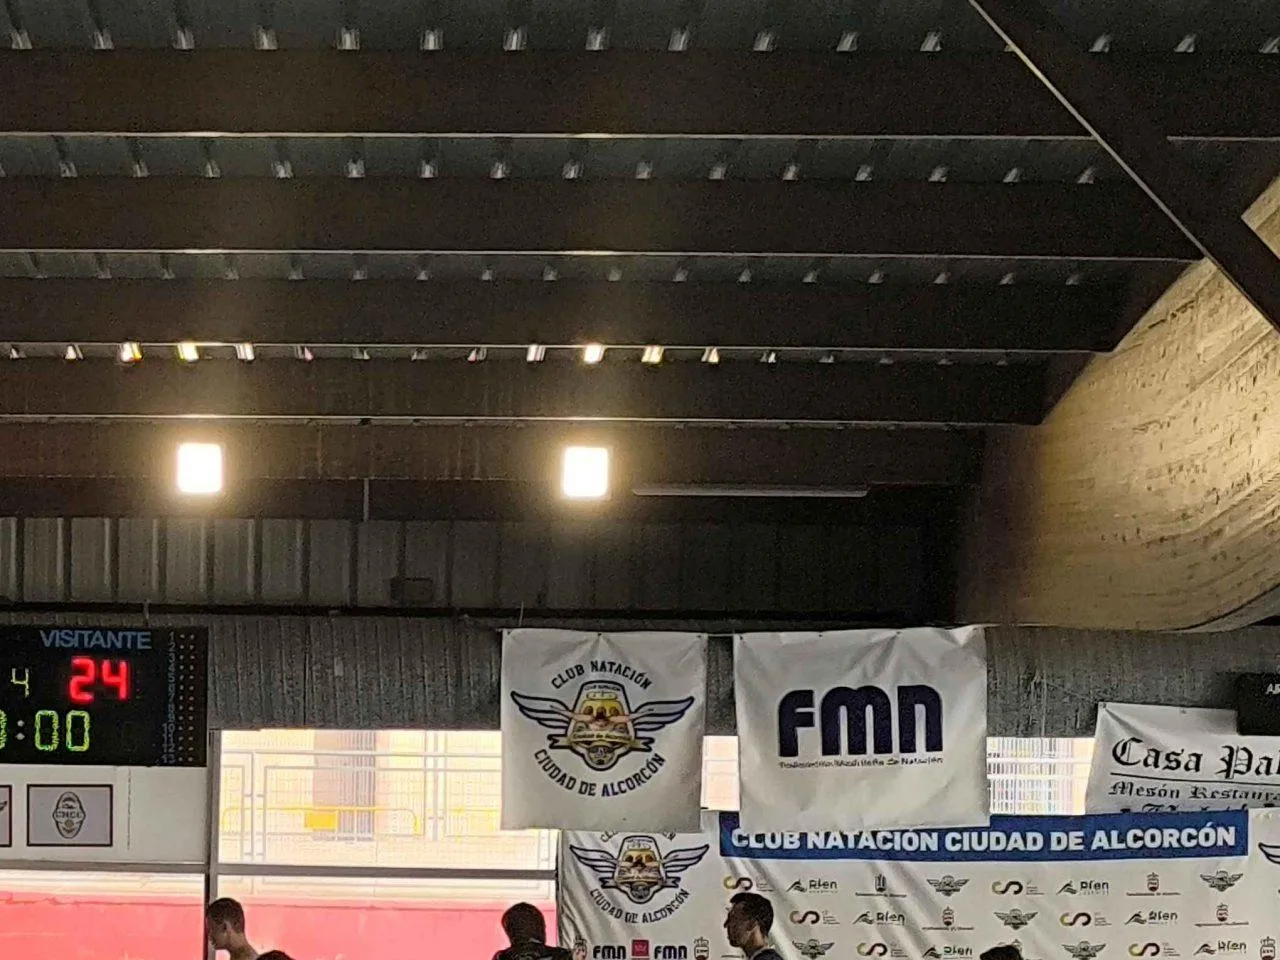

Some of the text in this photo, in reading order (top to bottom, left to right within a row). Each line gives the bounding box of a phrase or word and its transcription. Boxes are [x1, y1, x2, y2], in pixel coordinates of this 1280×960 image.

[40, 630, 152, 649] VISITANTE
[11, 668, 29, 697] 4
[69, 656, 128, 702] 24
[551, 660, 652, 690] CLUB NATACIÓN
[1112, 737, 1203, 773] Casa
[534, 749, 666, 797] CIUDAD DE ALCORCÓN
[1108, 781, 1180, 799] Mesón
[731, 821, 1236, 851] CLUB NATACIÓN CIUDAD DE ALCORCÓN
[590, 888, 623, 920] CIUDAD
